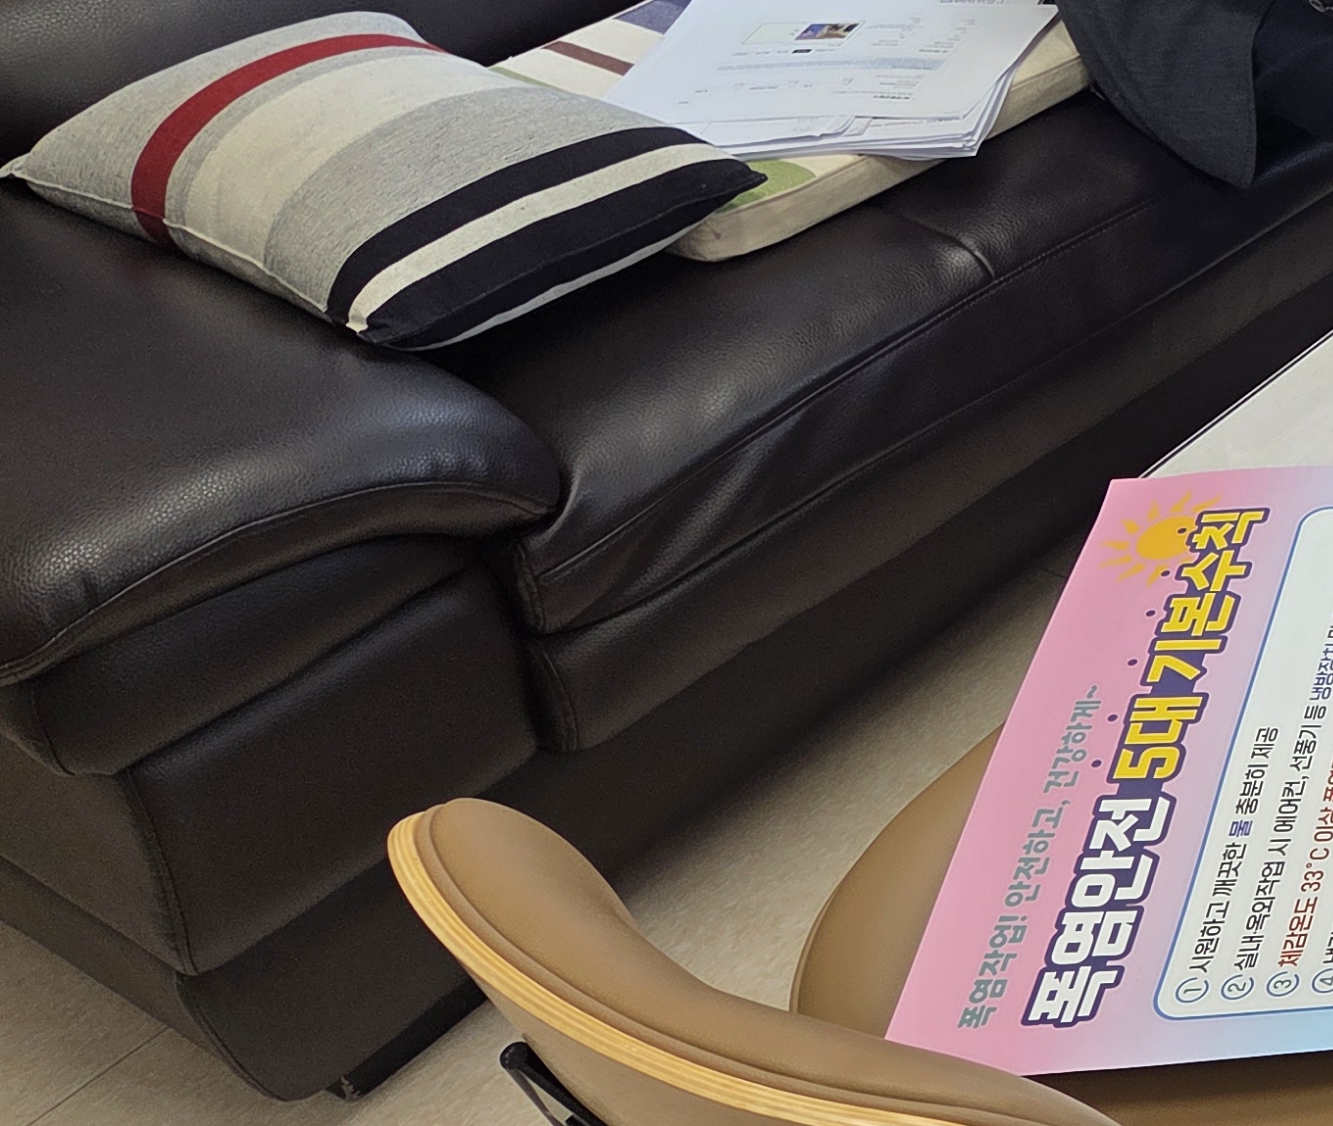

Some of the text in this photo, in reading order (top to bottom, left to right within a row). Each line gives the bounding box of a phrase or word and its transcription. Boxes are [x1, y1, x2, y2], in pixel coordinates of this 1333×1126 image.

[1303, 704, 1327, 720] 등
[1025, 508, 1267, 1025] 폭염안전 5대 기본수칙
[1251, 727, 1279, 759] 제공
[1290, 724, 1322, 771] 선풍기
[1235, 764, 1269, 815] 충분히
[1273, 776, 1310, 833] 에어컨,
[1228, 819, 1253, 837] 물
[1267, 838, 1292, 856] 시
[957, 685, 1102, 1028] 폭염작업! 안전하고, 건강하게~
[1212, 842, 1247, 896] 깨끗한
[1189, 900, 1230, 973] 시원하고
[1278, 896, 1318, 967] 체감온도
